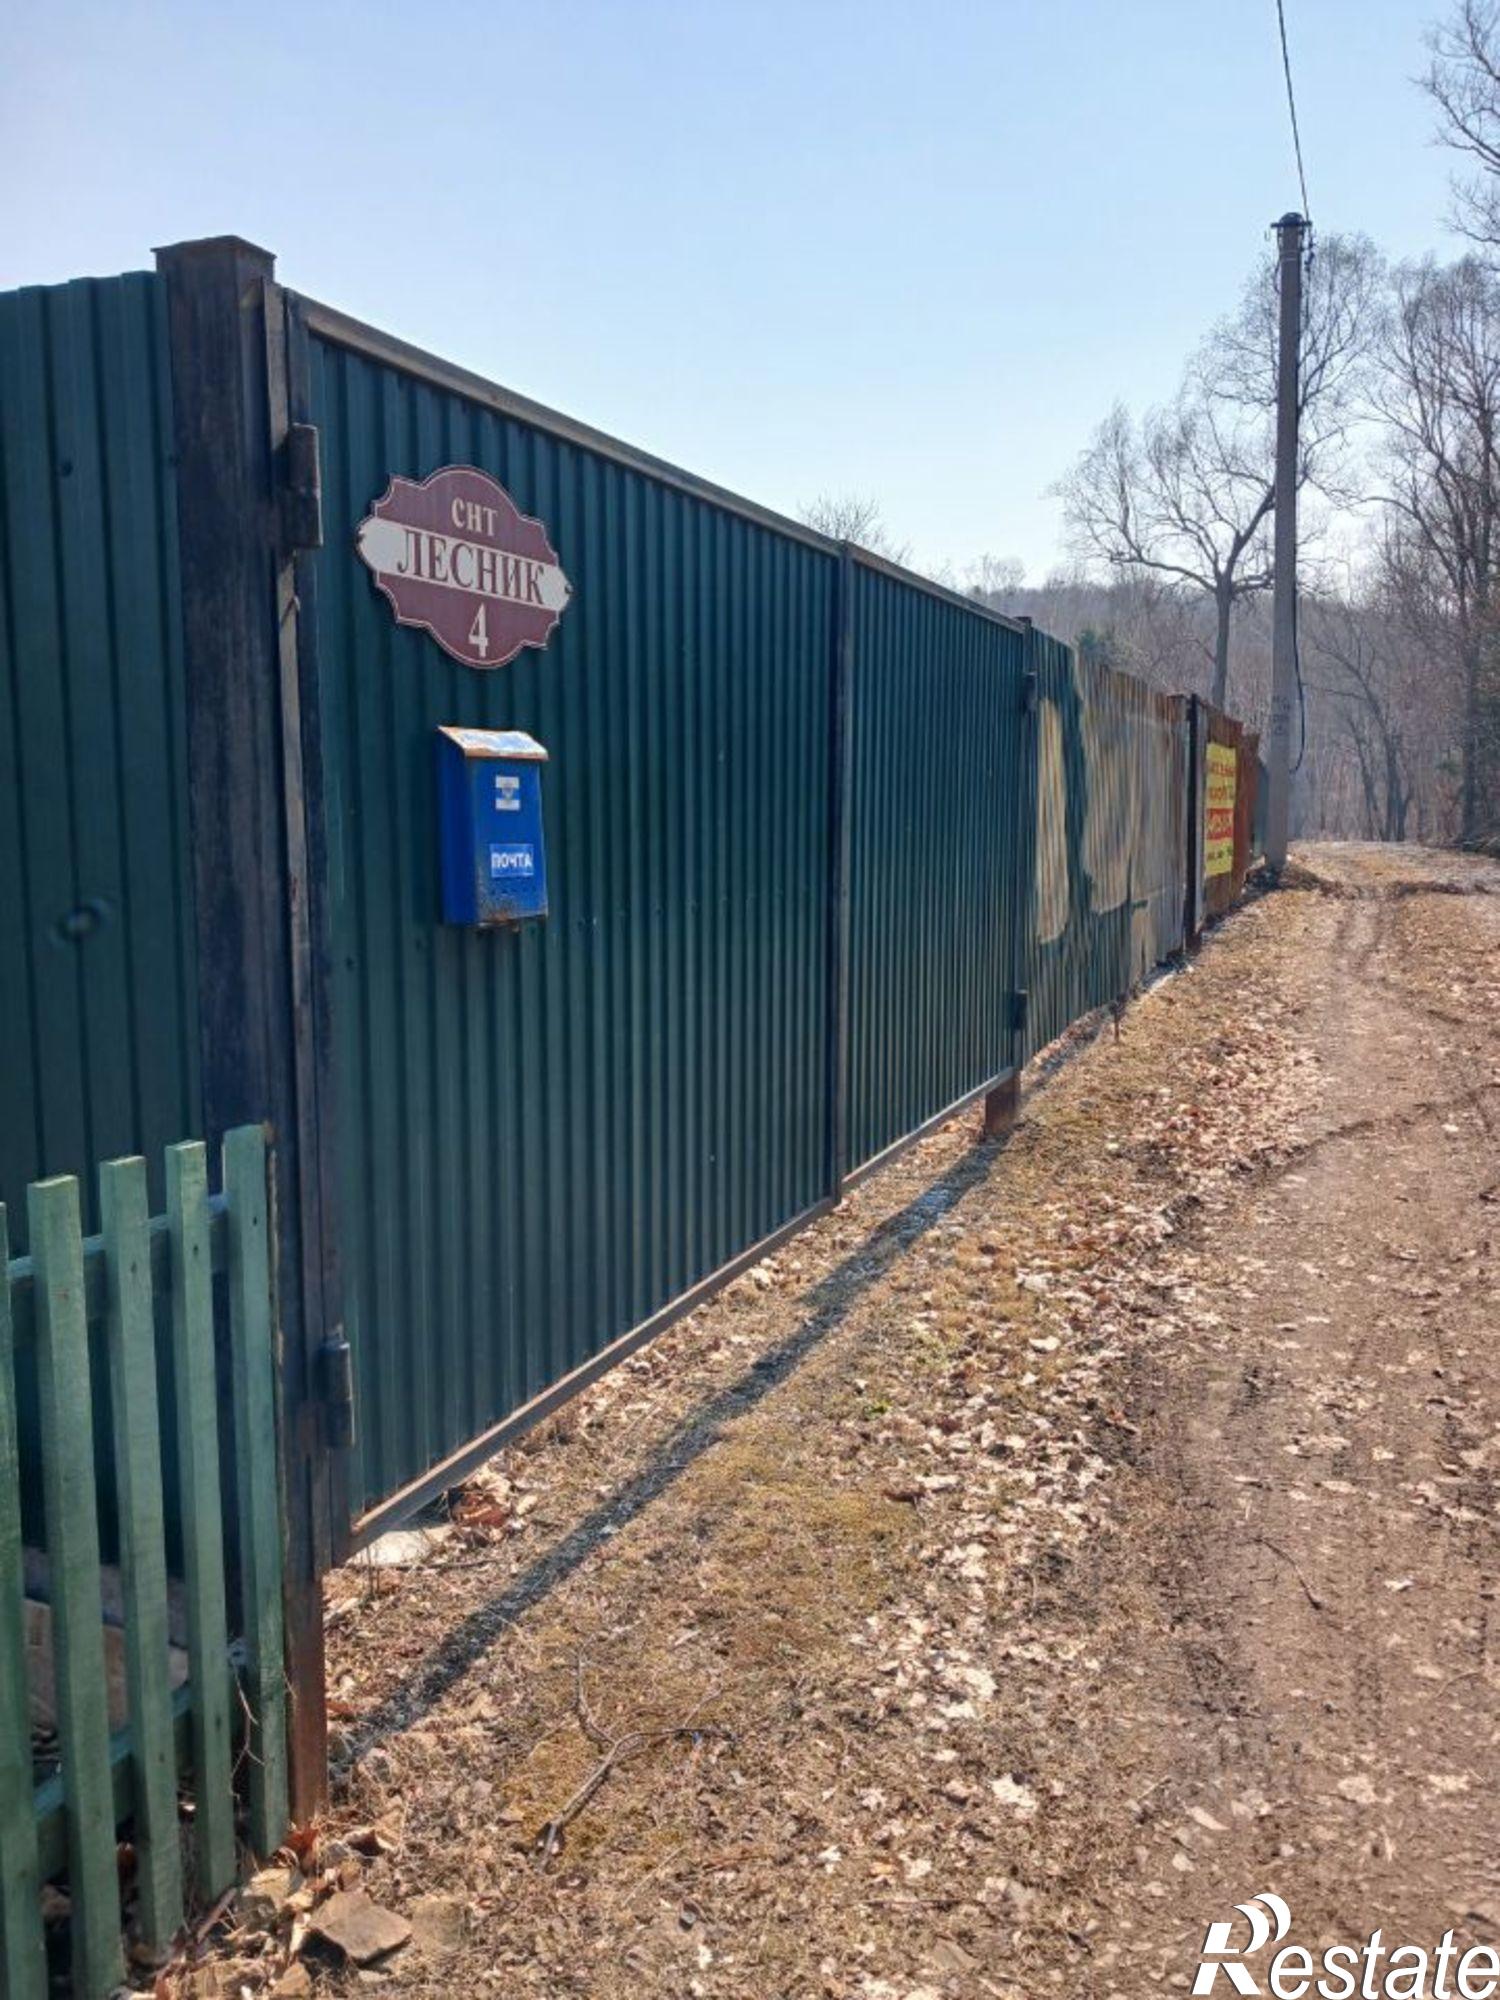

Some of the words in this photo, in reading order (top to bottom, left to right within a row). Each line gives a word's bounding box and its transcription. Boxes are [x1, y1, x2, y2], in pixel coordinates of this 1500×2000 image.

[451, 497, 498, 537] СНТ
[397, 529, 545, 605] ЛЕСНИК
[468, 603, 489, 658] 4
[490, 853, 533, 869] ПОЧТА
